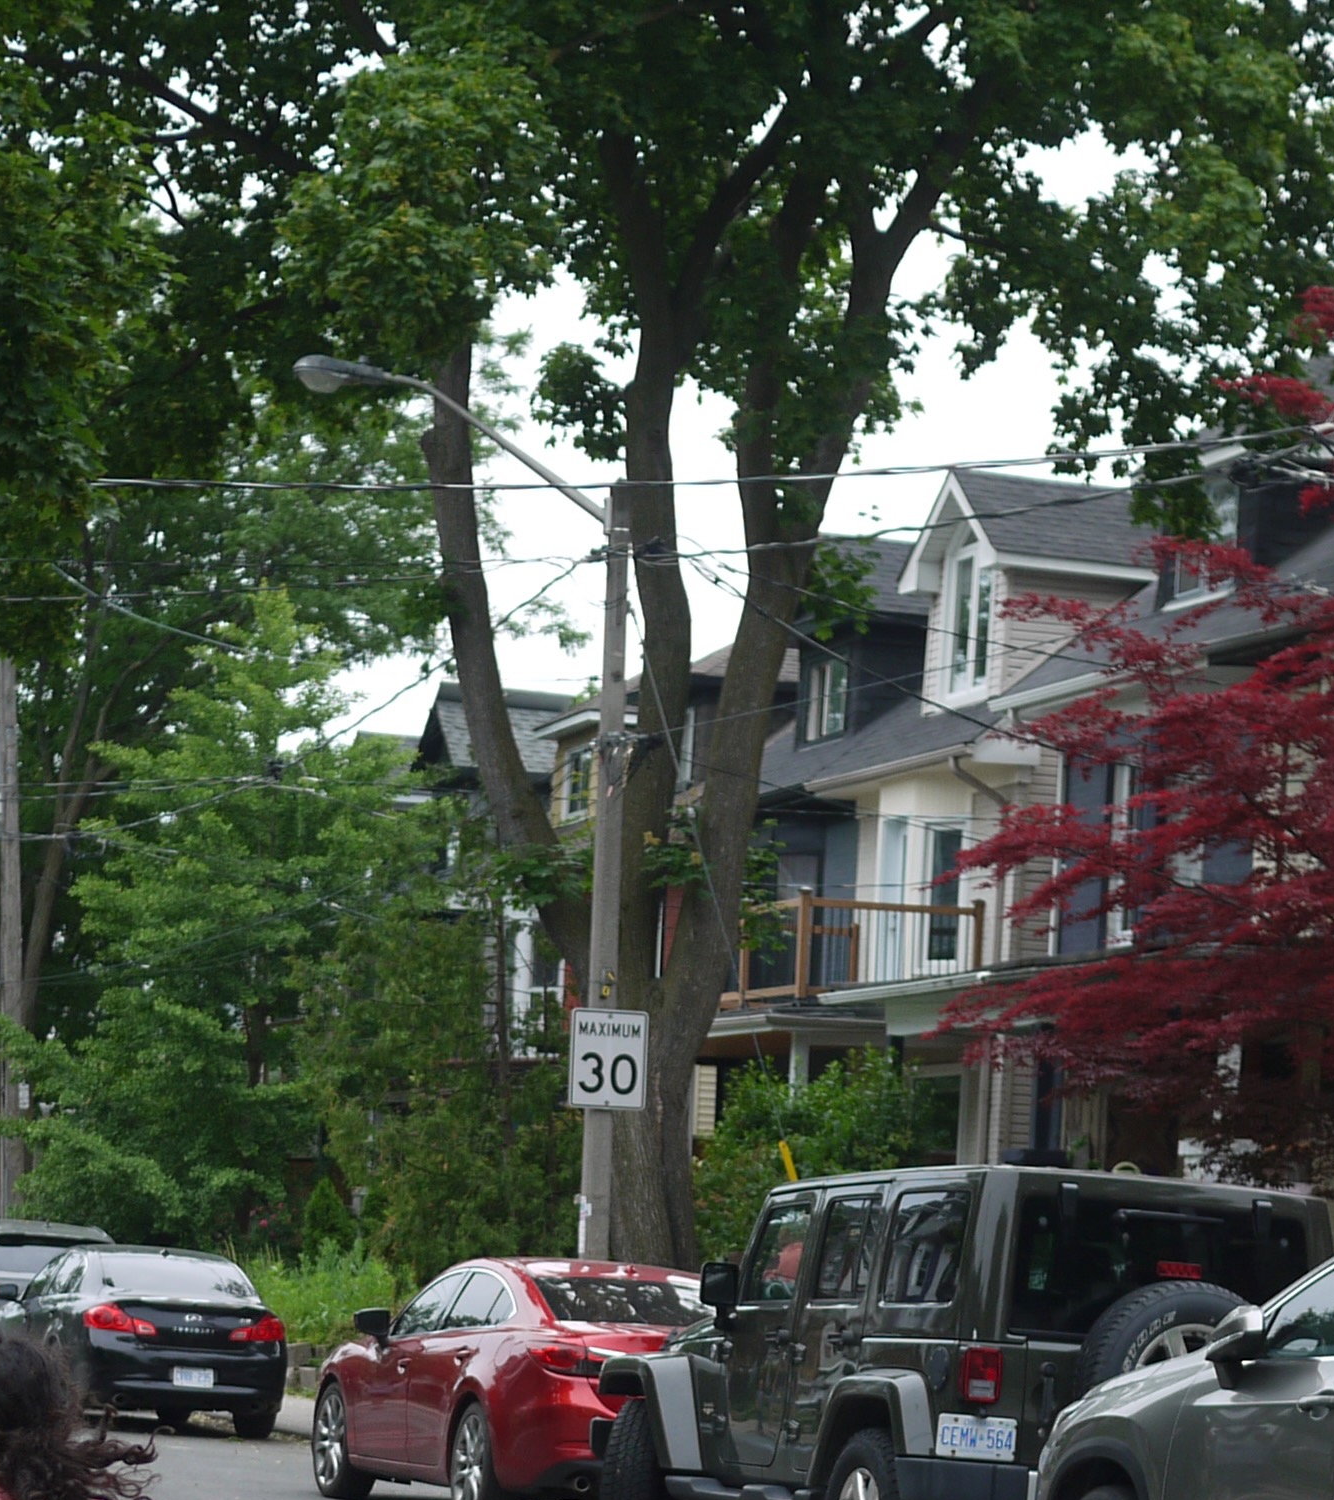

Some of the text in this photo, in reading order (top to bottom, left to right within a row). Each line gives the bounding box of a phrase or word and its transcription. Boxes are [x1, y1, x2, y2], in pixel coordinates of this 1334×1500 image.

[579, 1021, 641, 1038] MAXIMUM
[578, 1052, 638, 1095] 30
[941, 1425, 1013, 1450] CEMW 564
